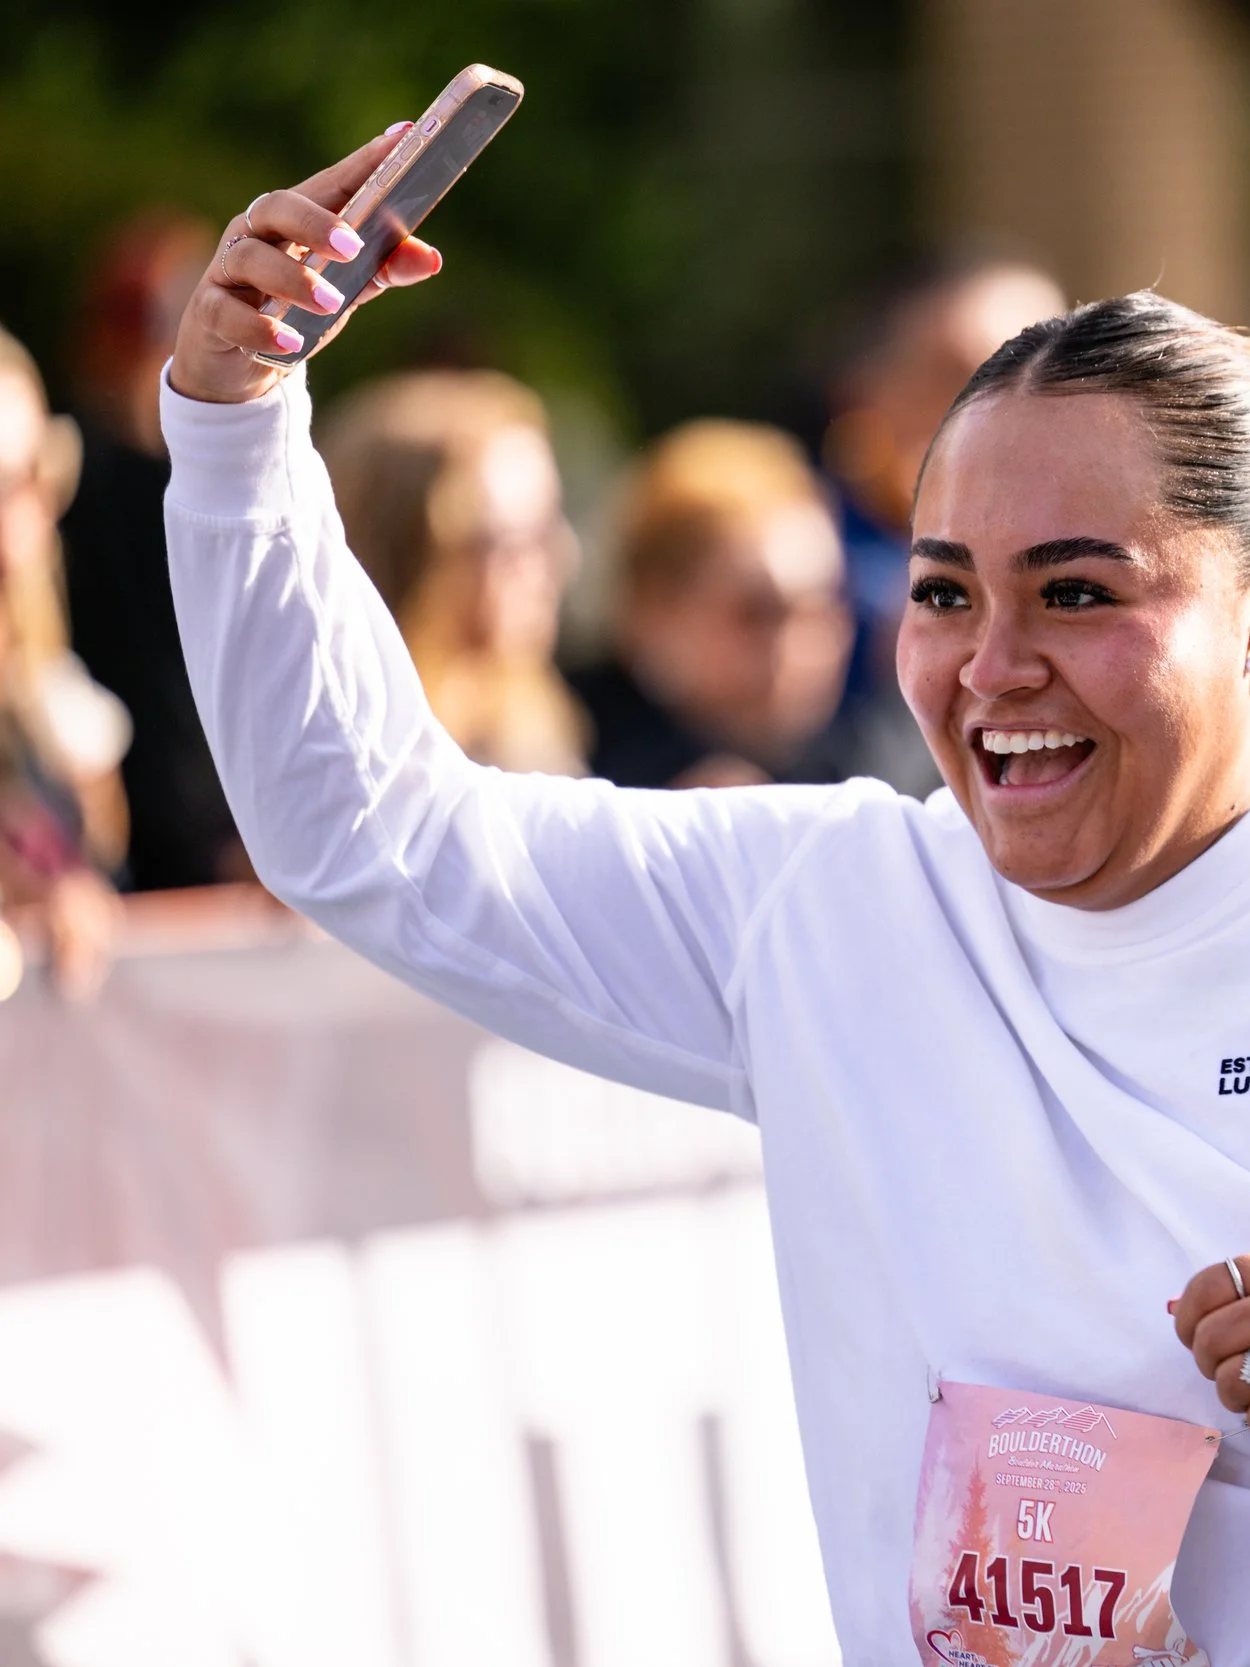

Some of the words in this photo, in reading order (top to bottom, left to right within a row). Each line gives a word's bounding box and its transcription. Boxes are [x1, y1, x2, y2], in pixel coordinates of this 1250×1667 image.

[988, 1430, 1107, 1472] BOULDERTHON
[996, 1473, 1042, 1489] SEPTEMBER
[1064, 1481, 1087, 1494] 2025
[1017, 1499, 1056, 1543] 5K
[948, 1549, 1127, 1641] 41517
[948, 1650, 976, 1661] HEART
